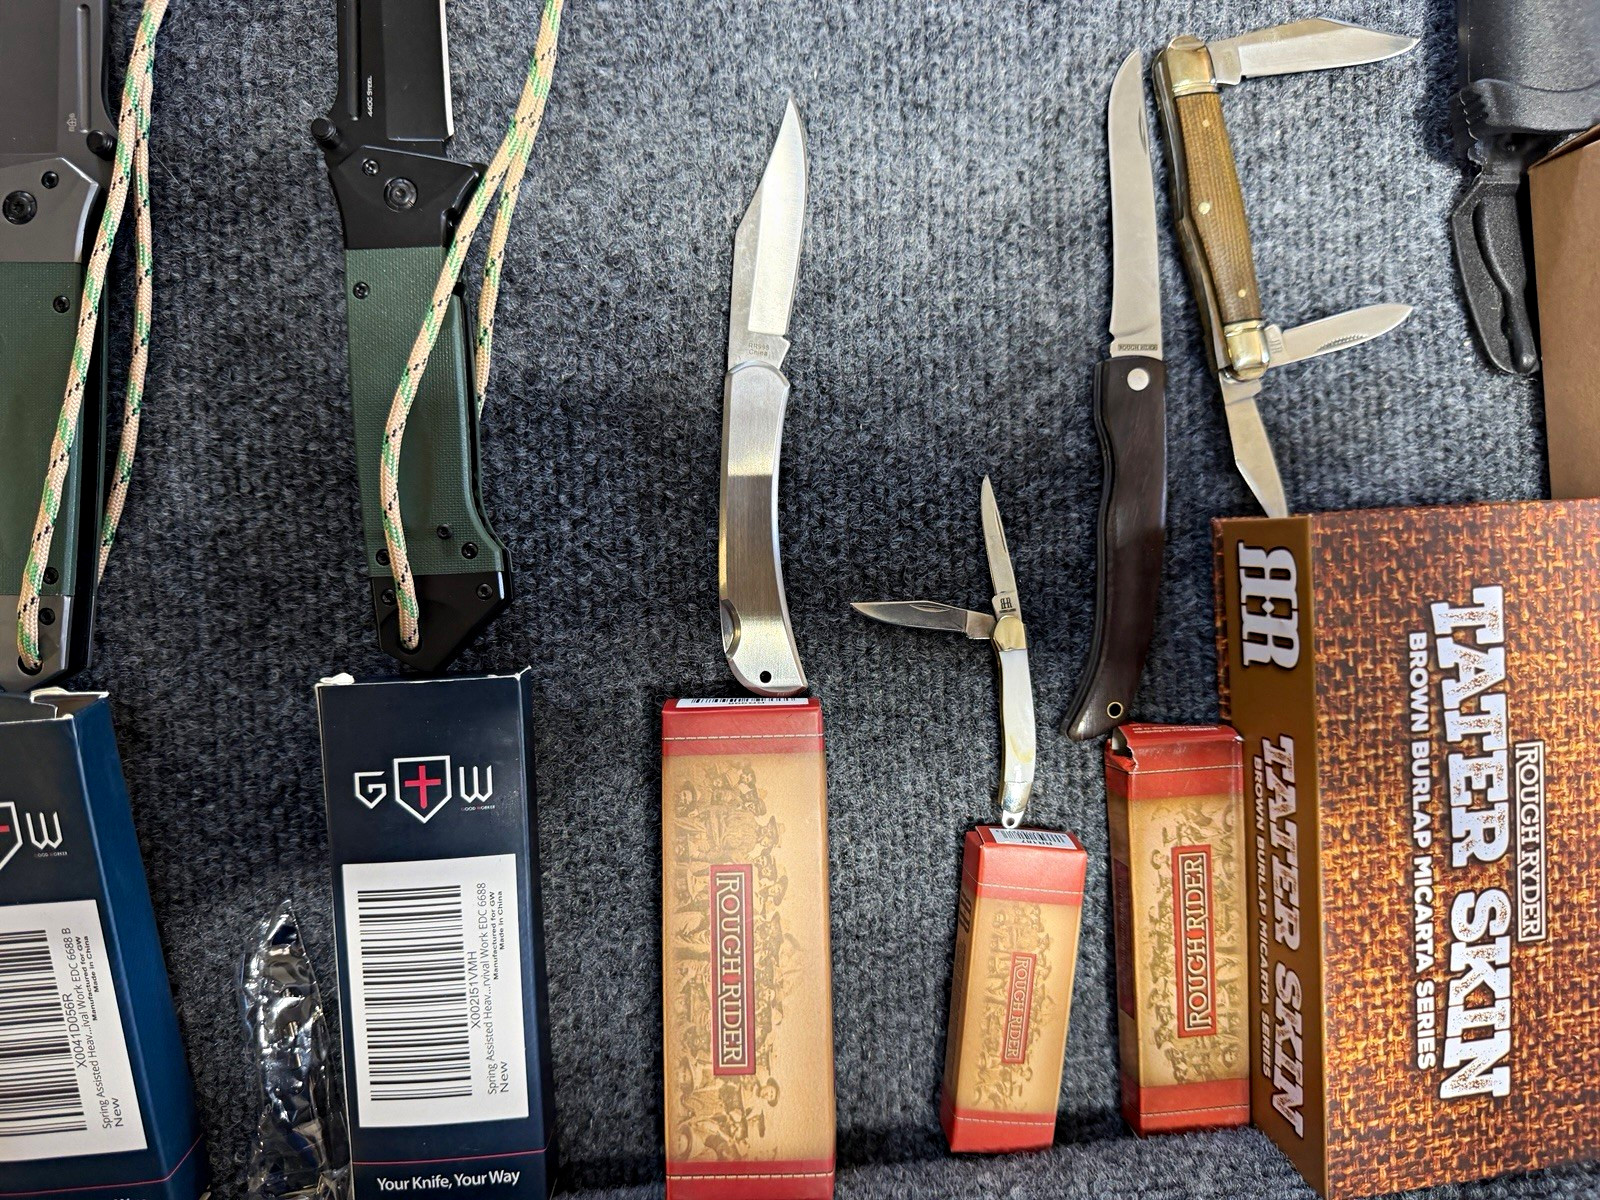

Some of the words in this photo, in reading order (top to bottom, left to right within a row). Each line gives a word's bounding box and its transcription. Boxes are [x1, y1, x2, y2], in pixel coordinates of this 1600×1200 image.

[1408, 631, 1431, 733] BROWN
[1430, 584, 1511, 868] TATER
[1253, 755, 1266, 832] BROWN
[1410, 740, 1433, 849] BURLAP
[1516, 742, 1540, 846] ROUGH
[1261, 734, 1300, 951] TATER
[476, 882, 487, 907] 6688
[489, 891, 496, 907] GW
[1184, 856, 1209, 932] RIDER
[1256, 835, 1268, 916] BURLAP
[1518, 849, 1542, 937] RYDER
[62, 927, 71, 935] B
[478, 909, 488, 930] EDC
[498, 917, 504, 926] in
[716, 875, 741, 976] ROUGH
[1413, 855, 1435, 974] MICARTA
[63, 936, 76, 960] 6688
[76, 936, 84, 952] GW
[84, 935, 92, 960] China
[89, 961, 95, 970] in
[478, 931, 489, 959] Work
[491, 923, 499, 980] Manufactured
[1258, 919, 1270, 1005] MICARTA
[69, 962, 80, 982] EDC
[74, 984, 86, 1010] Work
[82, 966, 98, 1021] Manufactured
[91, 970, 99, 993] Made
[1013, 958, 1029, 1014] ROUGH
[1187, 937, 1212, 1027] ROUGH
[1439, 888, 1512, 1099] SKIN
[62, 992, 88, 1068] X0041D056R
[484, 1021, 495, 1061] Assisted
[719, 982, 742, 1063] RIDER
[1007, 1015, 1023, 1058] RIDER
[1260, 1009, 1272, 1080] SERIES
[1416, 979, 1437, 1070] SERIES
[499, 1061, 510, 1093] New
[1271, 961, 1304, 1140] SKIN
[89, 1060, 105, 1098] Assisted
[488, 1063, 499, 1095] Spring
[100, 1099, 112, 1129] Spring
[112, 1097, 124, 1128] New
[376, 1177, 410, 1191] Your
[412, 1174, 453, 1190] Knife,
[453, 1172, 488, 1187] Your
[488, 1169, 520, 1186] Way
